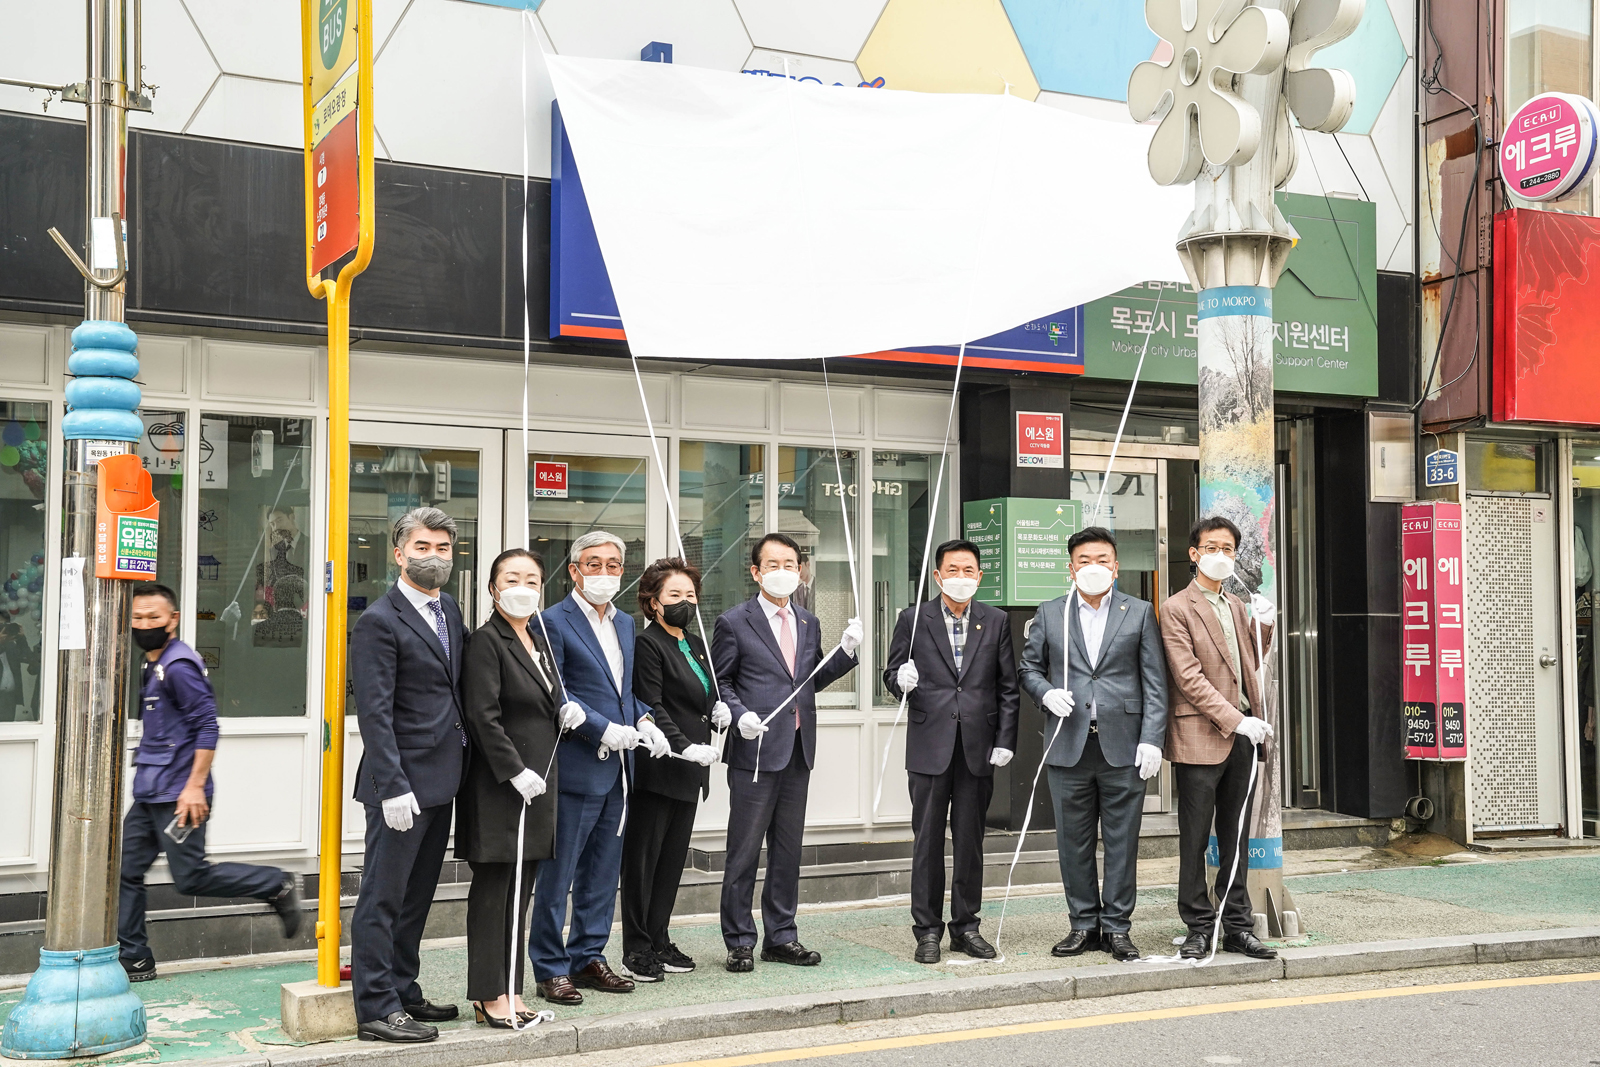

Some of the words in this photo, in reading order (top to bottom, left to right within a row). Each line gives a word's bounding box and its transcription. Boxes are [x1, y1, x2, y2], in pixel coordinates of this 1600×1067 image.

[323, 7, 342, 54] BUS
[323, 88, 347, 125] 로데오광장
[1505, 123, 1577, 172] 에크루
[1207, 297, 1219, 309] TO
[1222, 296, 1256, 307] MOKPO
[1111, 306, 1176, 339] 목포시
[1151, 345, 1169, 358] city
[1173, 346, 1197, 358] Urba
[1275, 353, 1314, 368] Support
[1316, 356, 1349, 370] Center
[1025, 426, 1054, 441] 에스원
[1018, 456, 1043, 465] SECOM
[539, 471, 563, 483] 에스원
[1430, 466, 1455, 482] 33-6
[1016, 519, 1040, 527] 어울림회관
[98, 521, 107, 564] 유달정보
[994, 533, 1001, 541] 4F
[1017, 533, 1059, 542] 목포문화도시센터
[1017, 546, 1031, 555] 목포시
[1029, 561, 1056, 570] 역사문화관
[1403, 557, 1431, 677] 에크루
[1437, 557, 1463, 678] 에크루
[1407, 718, 1430, 730] 9450
[1445, 720, 1461, 731] 9450
[1408, 732, 1434, 743] -5712
[1446, 733, 1464, 744] -5712
